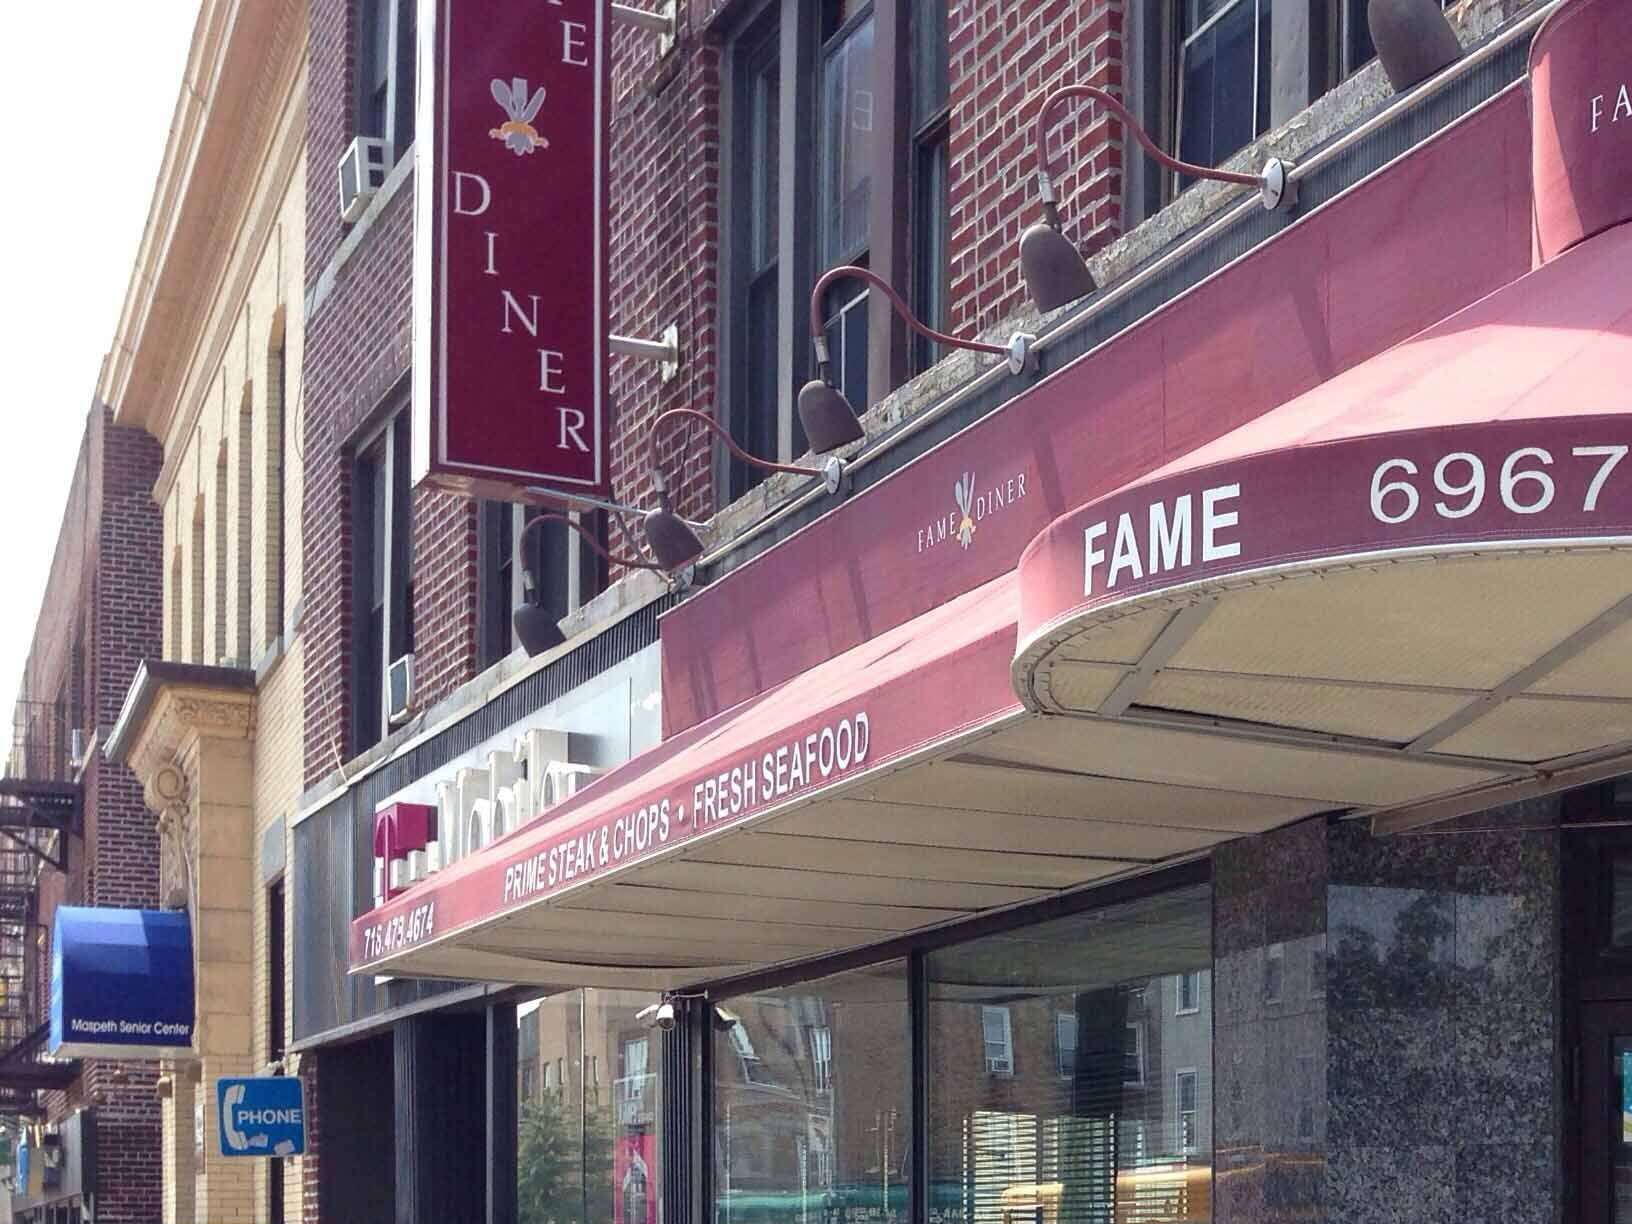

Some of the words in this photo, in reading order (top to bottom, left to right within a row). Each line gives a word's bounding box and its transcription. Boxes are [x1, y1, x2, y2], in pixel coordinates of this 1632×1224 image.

[453, 171, 590, 453] DINER
[918, 515, 958, 553] FAME
[977, 472, 1027, 521] DINER
[1083, 482, 1241, 597] FAME
[1370, 445, 1629, 523] 6967
[503, 853, 546, 903] PRIME
[548, 829, 598, 885] STEAK
[598, 829, 610, 866] &
[612, 799, 671, 858] CHOPS
[692, 771, 757, 831] FRESH
[762, 711, 870, 801] SEAFOOD
[72, 1019, 118, 1034] Maspeth
[119, 1021, 152, 1035] Senior
[152, 1022, 191, 1036] Center
[237, 1109, 302, 1124] PHONE
